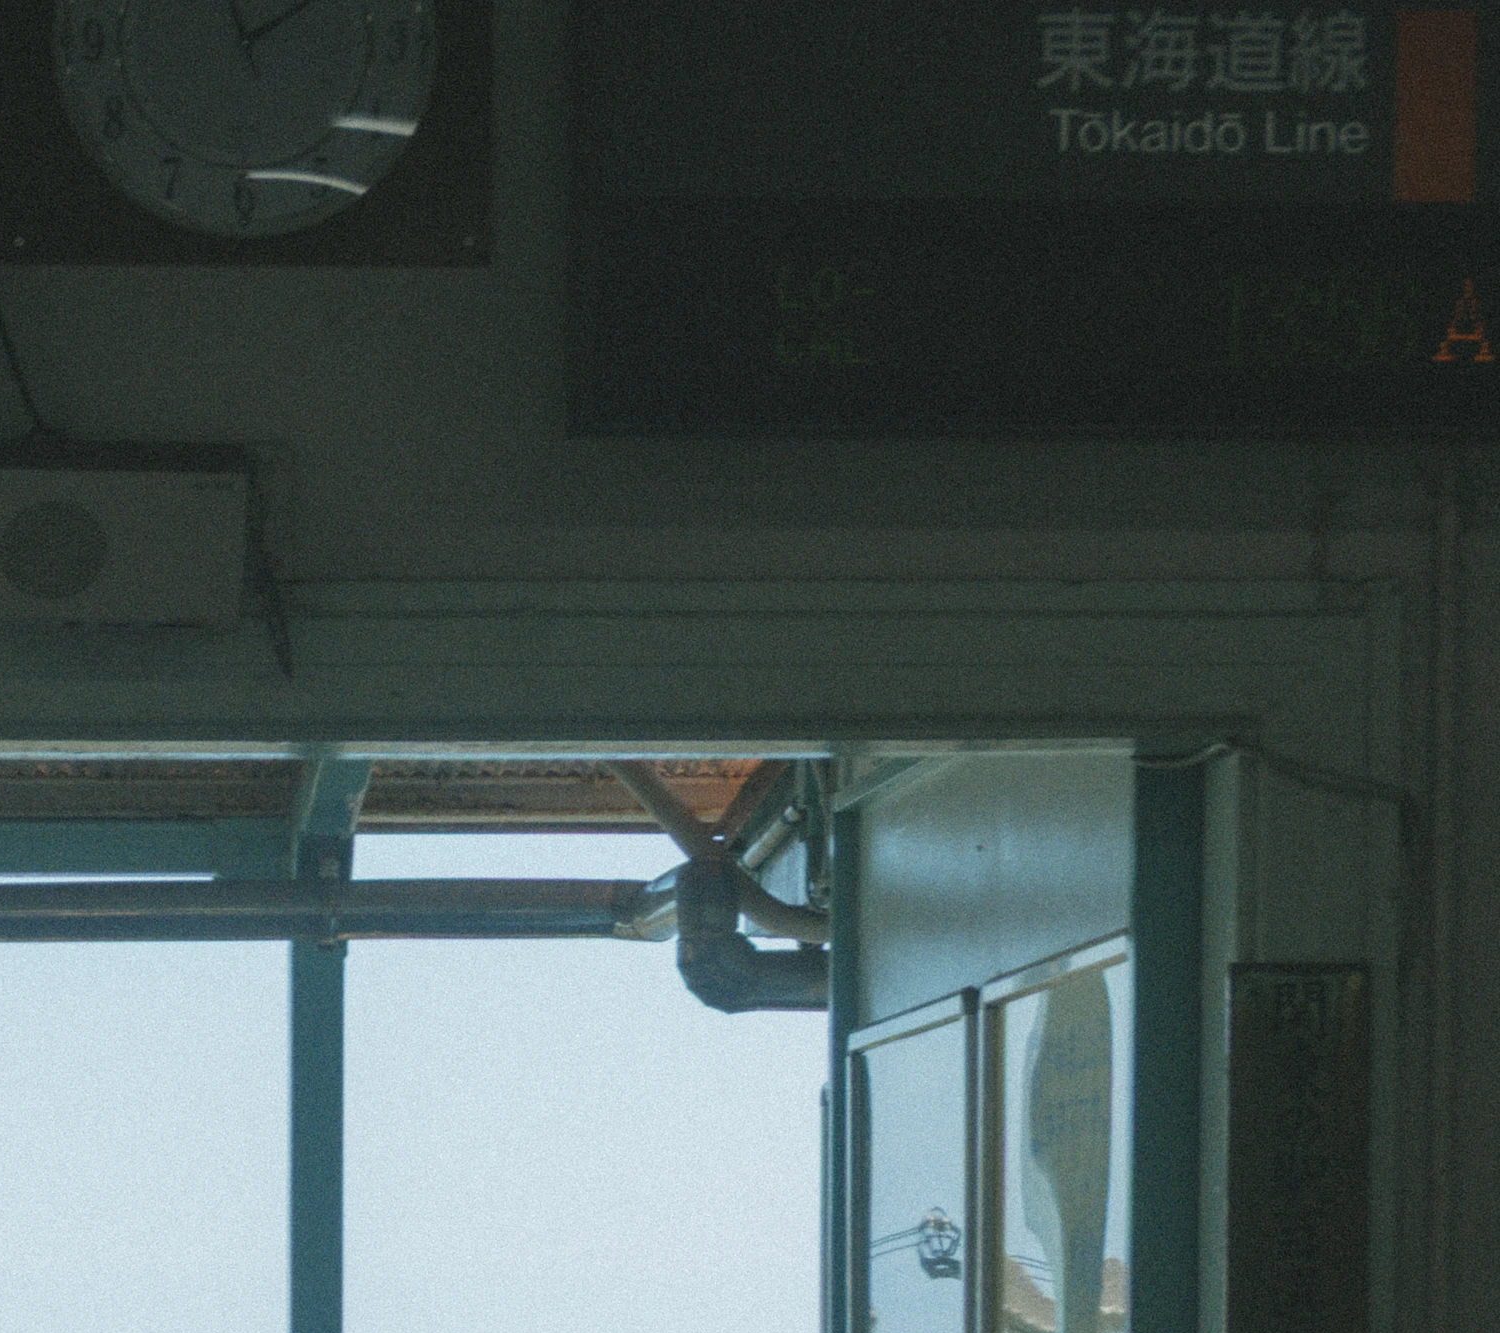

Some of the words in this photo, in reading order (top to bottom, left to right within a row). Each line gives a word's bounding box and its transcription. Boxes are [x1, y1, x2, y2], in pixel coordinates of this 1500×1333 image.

[1036, 6, 1368, 93] 東海道線
[1049, 108, 1247, 154] Tōkaidō
[1264, 110, 1371, 154] Line
[1429, 276, 1497, 365] A
